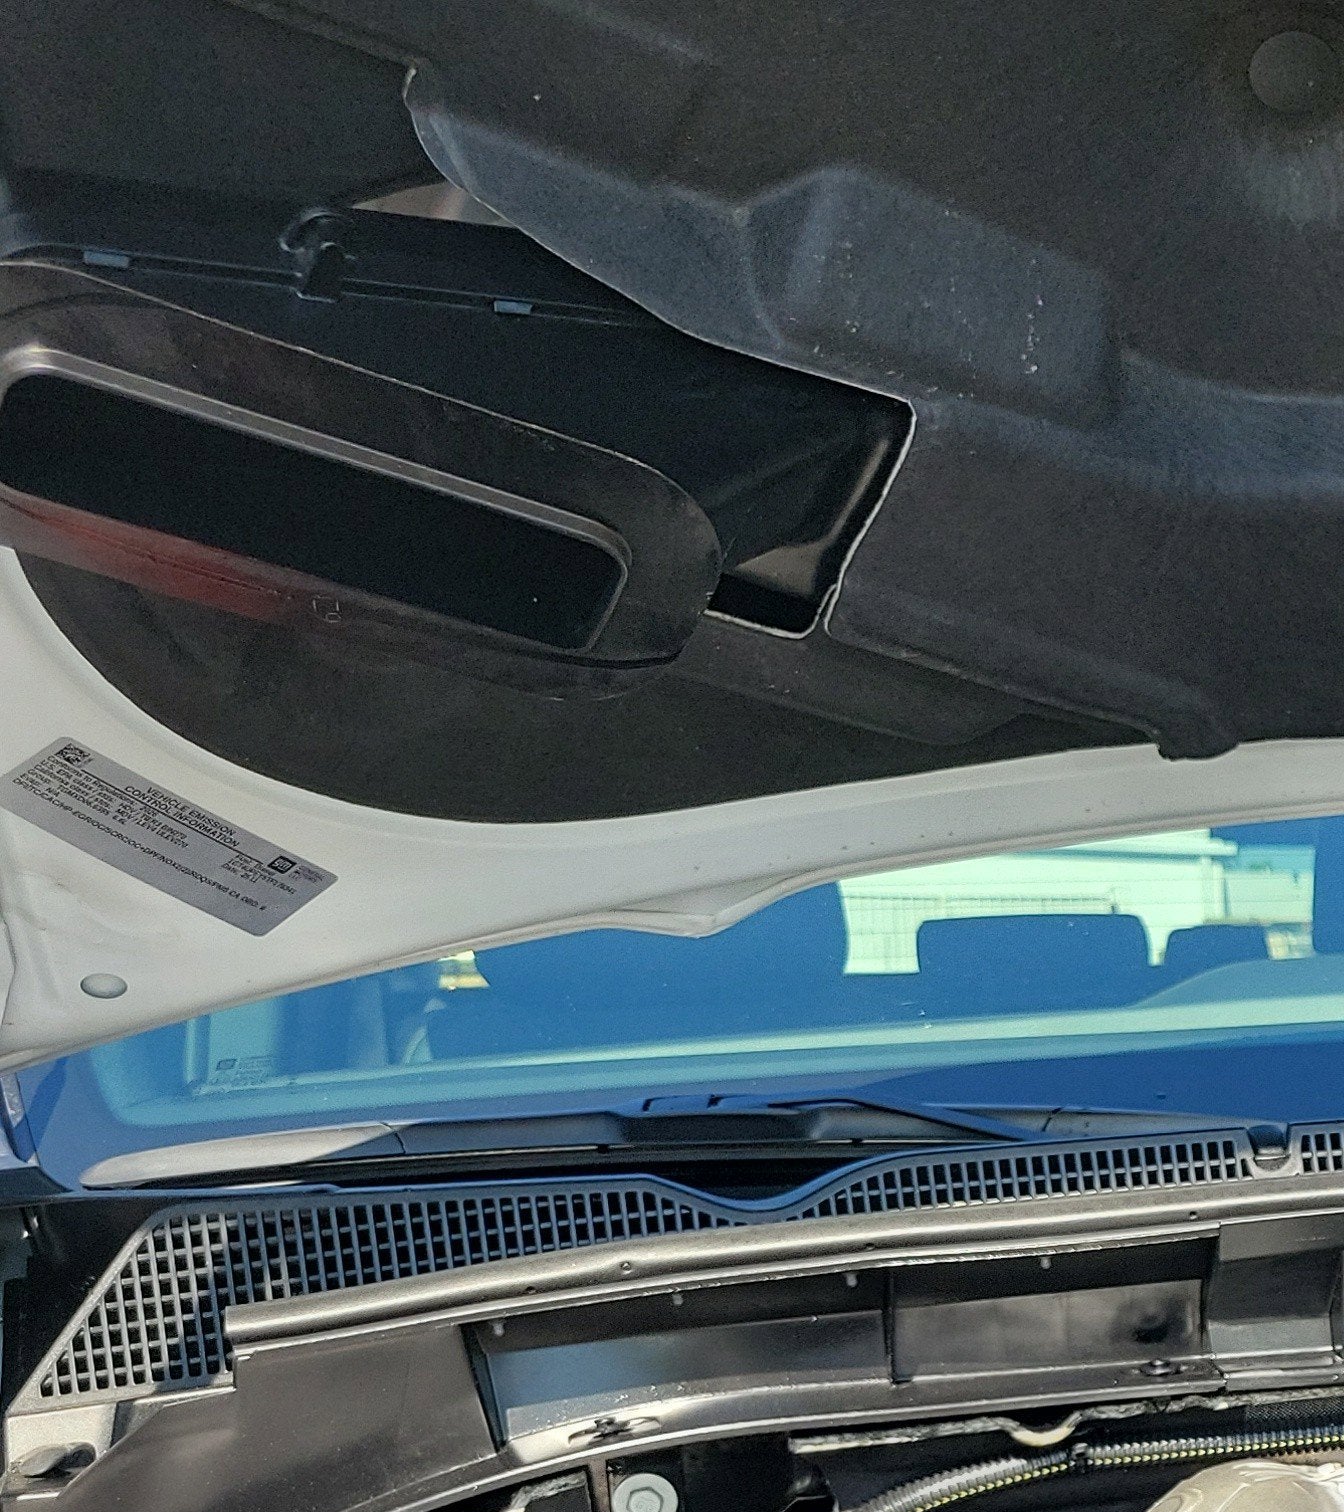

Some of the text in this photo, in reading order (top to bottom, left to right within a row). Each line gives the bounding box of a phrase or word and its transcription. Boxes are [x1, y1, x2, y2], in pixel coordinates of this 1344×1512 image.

[122, 784, 241, 848] CONTROL INFORMATION
[143, 786, 237, 837] VEHICLE EMISSION
